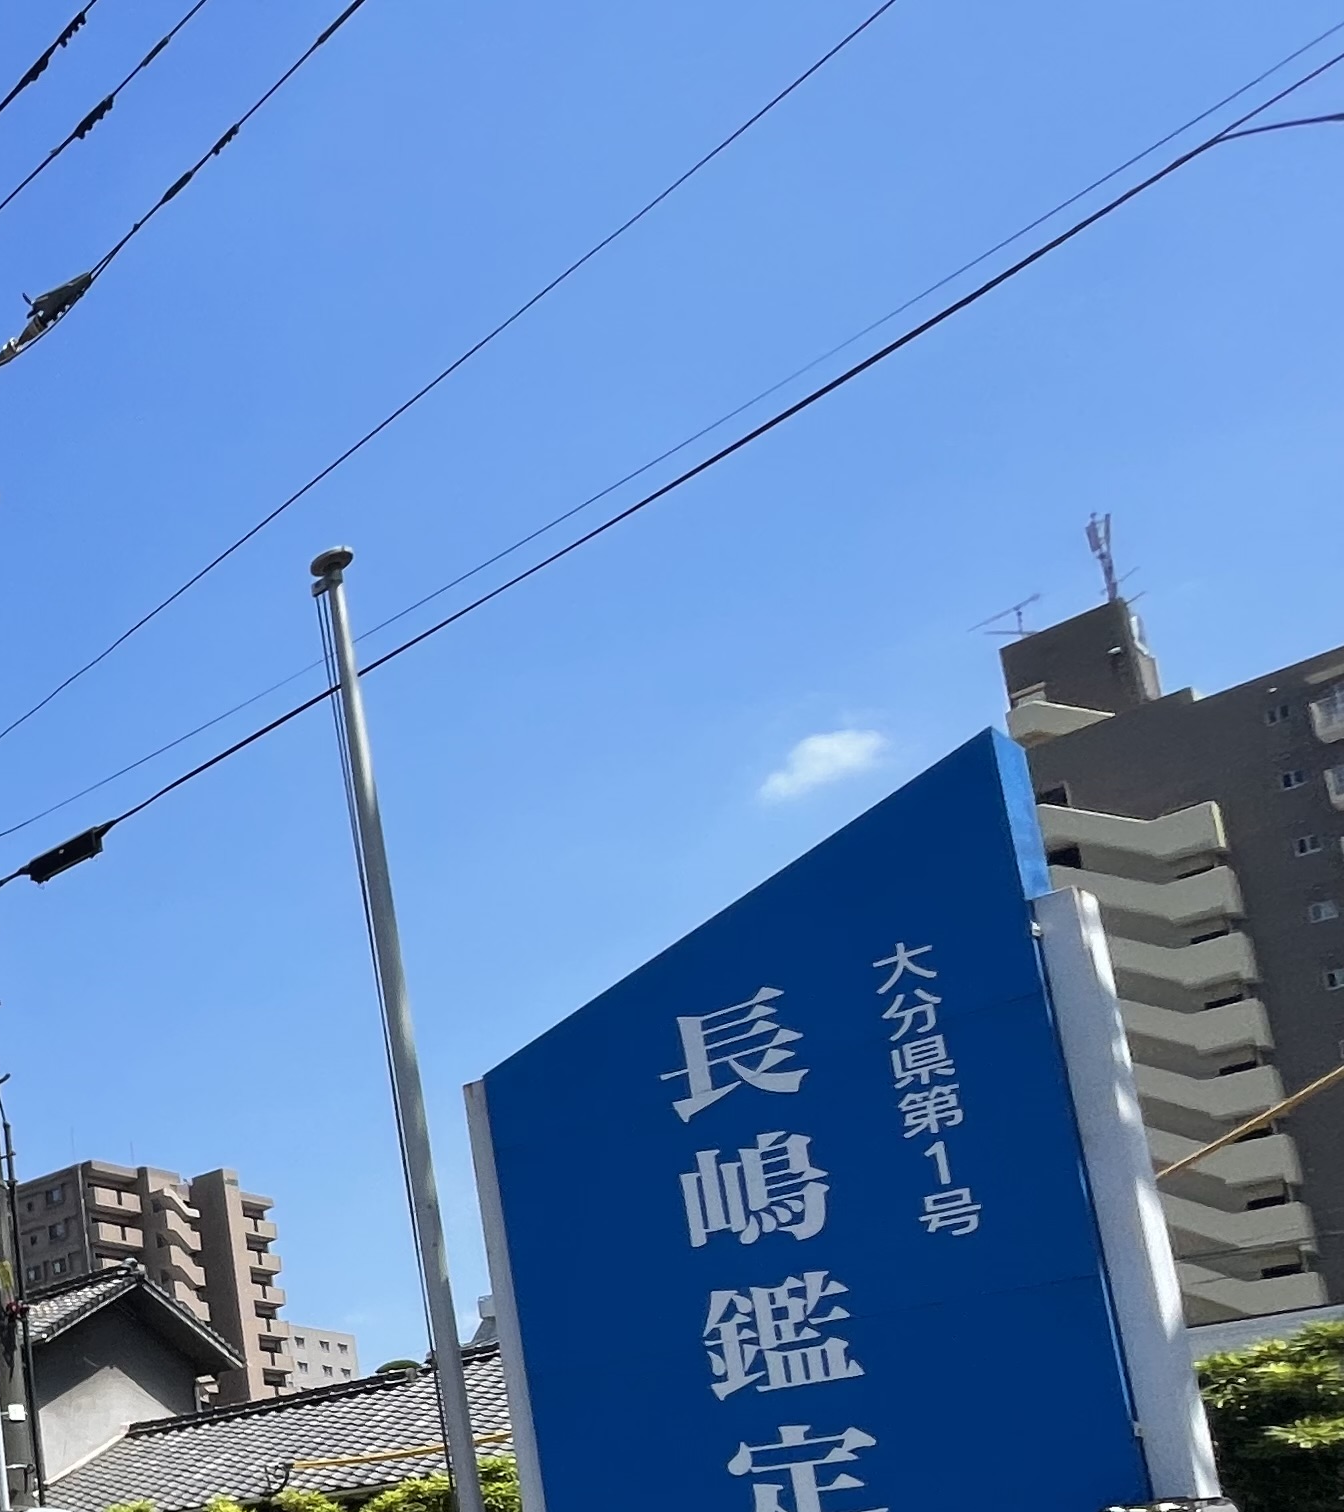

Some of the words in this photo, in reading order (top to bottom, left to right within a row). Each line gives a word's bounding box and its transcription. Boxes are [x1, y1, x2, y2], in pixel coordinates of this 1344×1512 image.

[872, 941, 982, 1237] 大分県第1号
